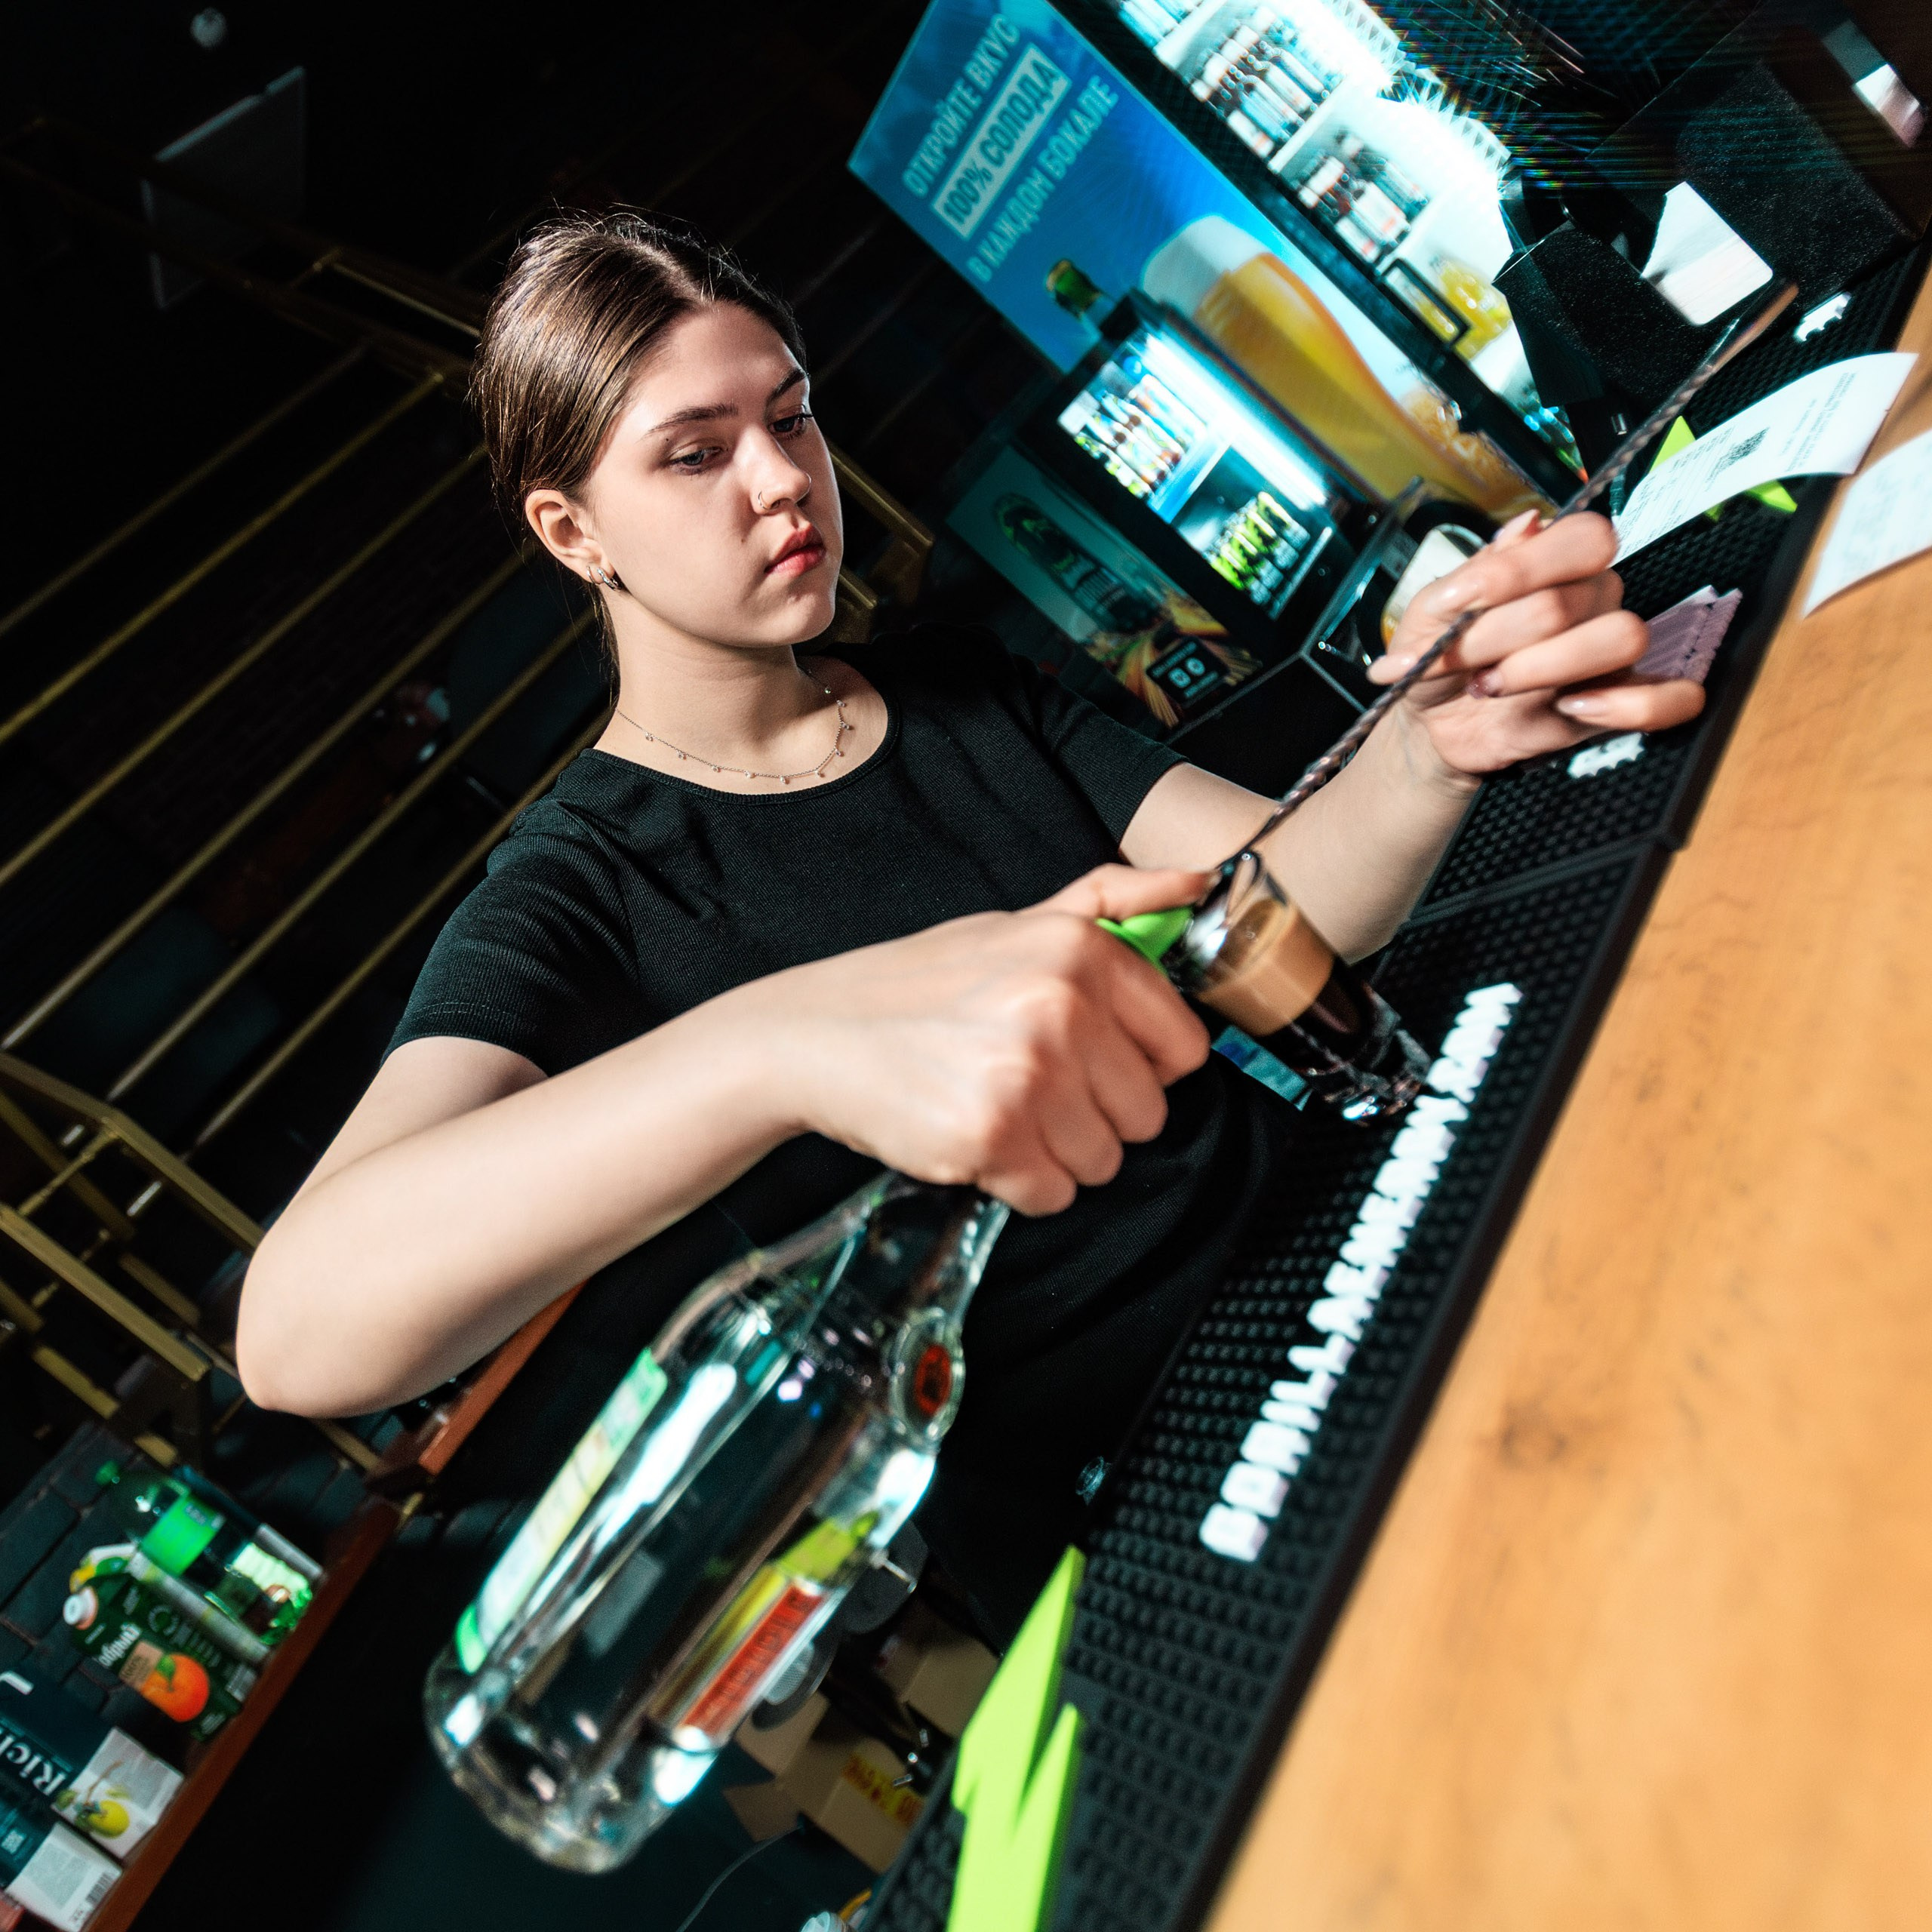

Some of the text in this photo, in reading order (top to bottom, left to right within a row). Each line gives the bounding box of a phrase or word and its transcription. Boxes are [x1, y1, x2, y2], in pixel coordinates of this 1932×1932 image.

[903, 14, 1019, 197] ОТКРОЙТЕ ВКУС
[943, 58, 1059, 224] 100% СОЛОДА
[967, 75, 1119, 282] В КАЖДОМ БОКАЛЕ
